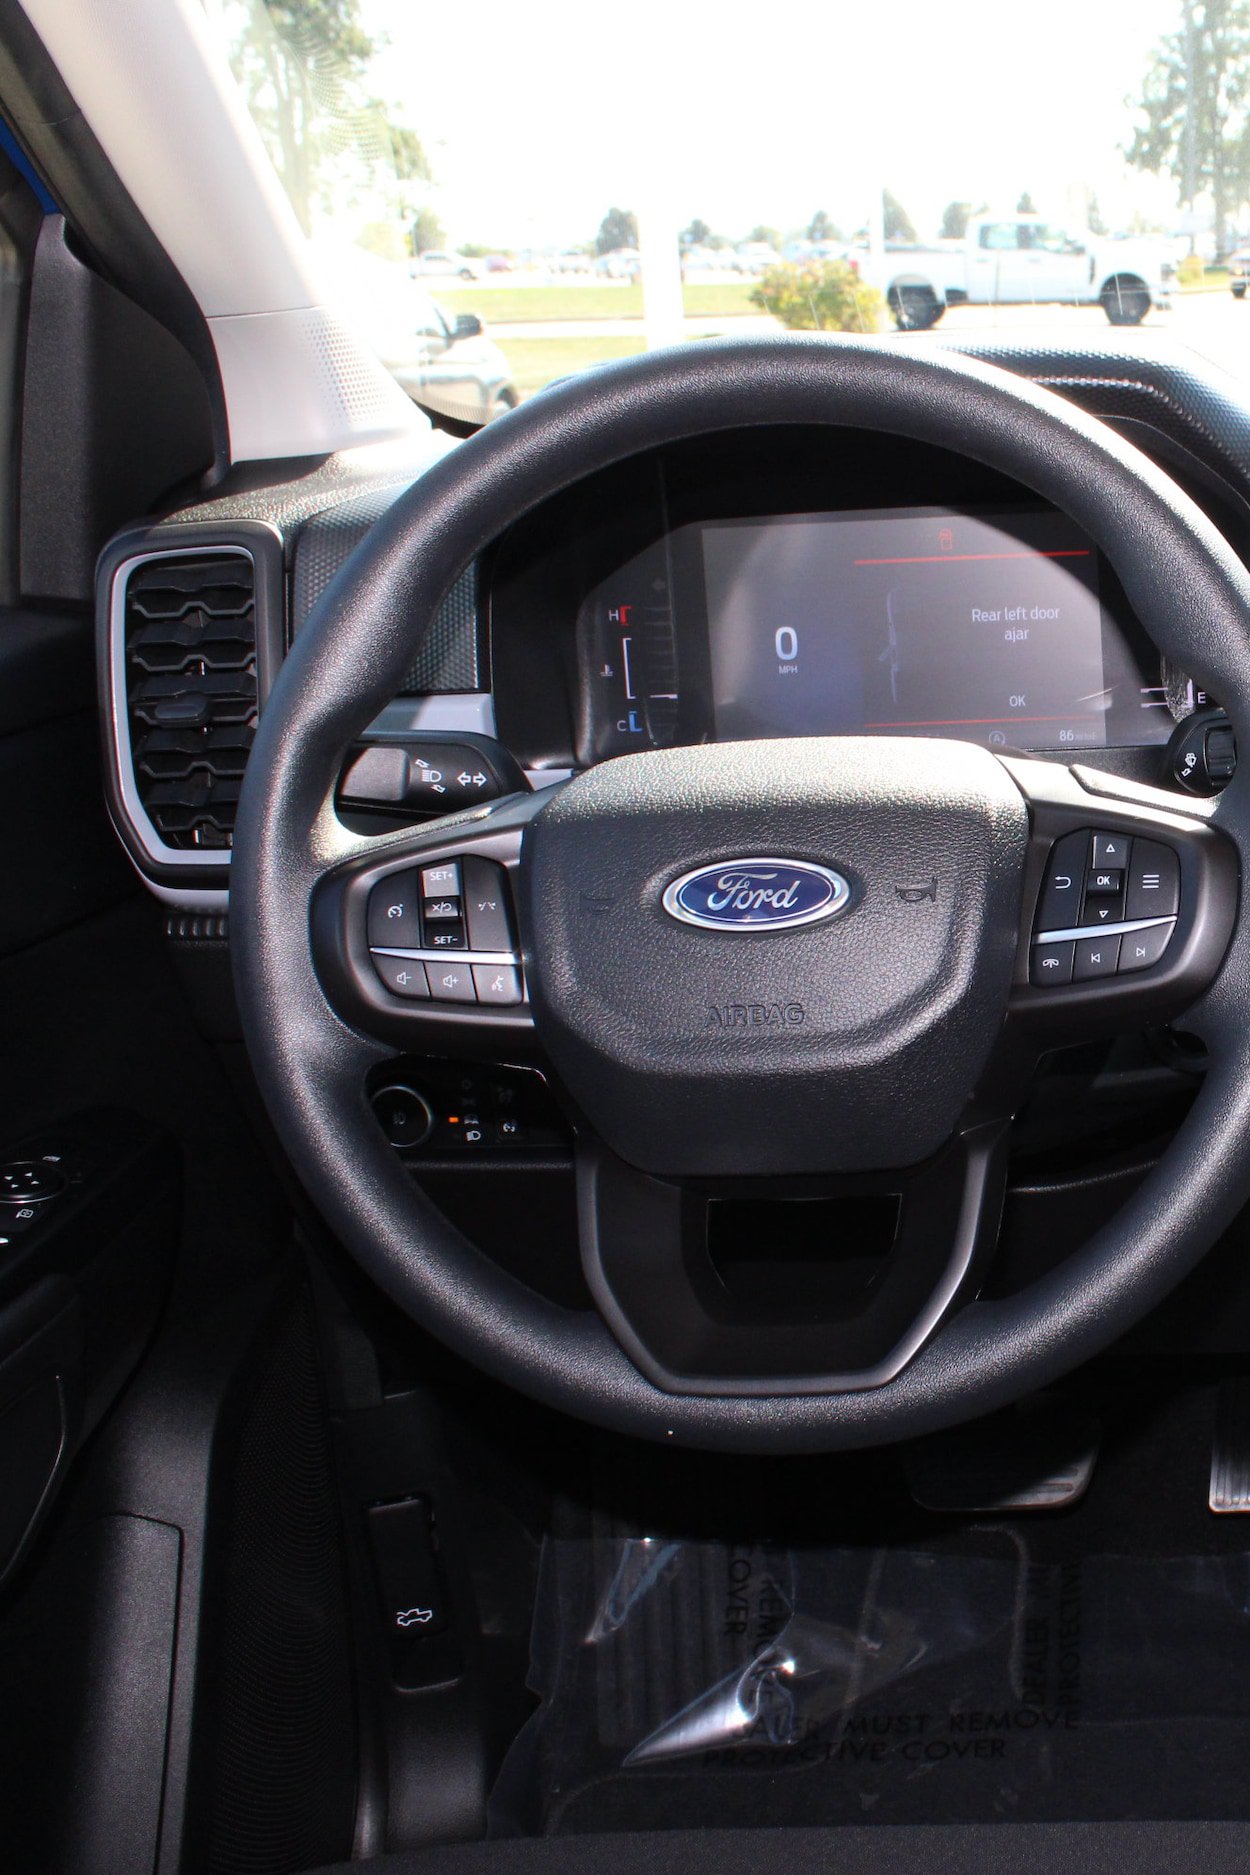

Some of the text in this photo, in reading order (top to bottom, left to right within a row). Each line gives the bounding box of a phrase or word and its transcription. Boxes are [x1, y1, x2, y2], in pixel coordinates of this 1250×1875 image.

[608, 609, 619, 622] H
[971, 605, 1060, 622] Rear left door
[1004, 626, 1030, 643] ajar
[774, 626, 799, 661] 0
[778, 664, 799, 675] MPH
[1009, 695, 1026, 707] OK
[1197, 691, 1206, 704] E
[616, 719, 627, 732] C
[1059, 729, 1074, 741] 86
[1096, 875, 1111, 886] OK
[706, 871, 801, 911] Ford
[705, 1003, 805, 1029] AIRBAG
[722, 1544, 751, 1636] OVER
[843, 1712, 930, 1735] MUST
[950, 1709, 1080, 1734] REMOVE
[702, 1738, 1008, 1768] PROTECTIVE COVER
